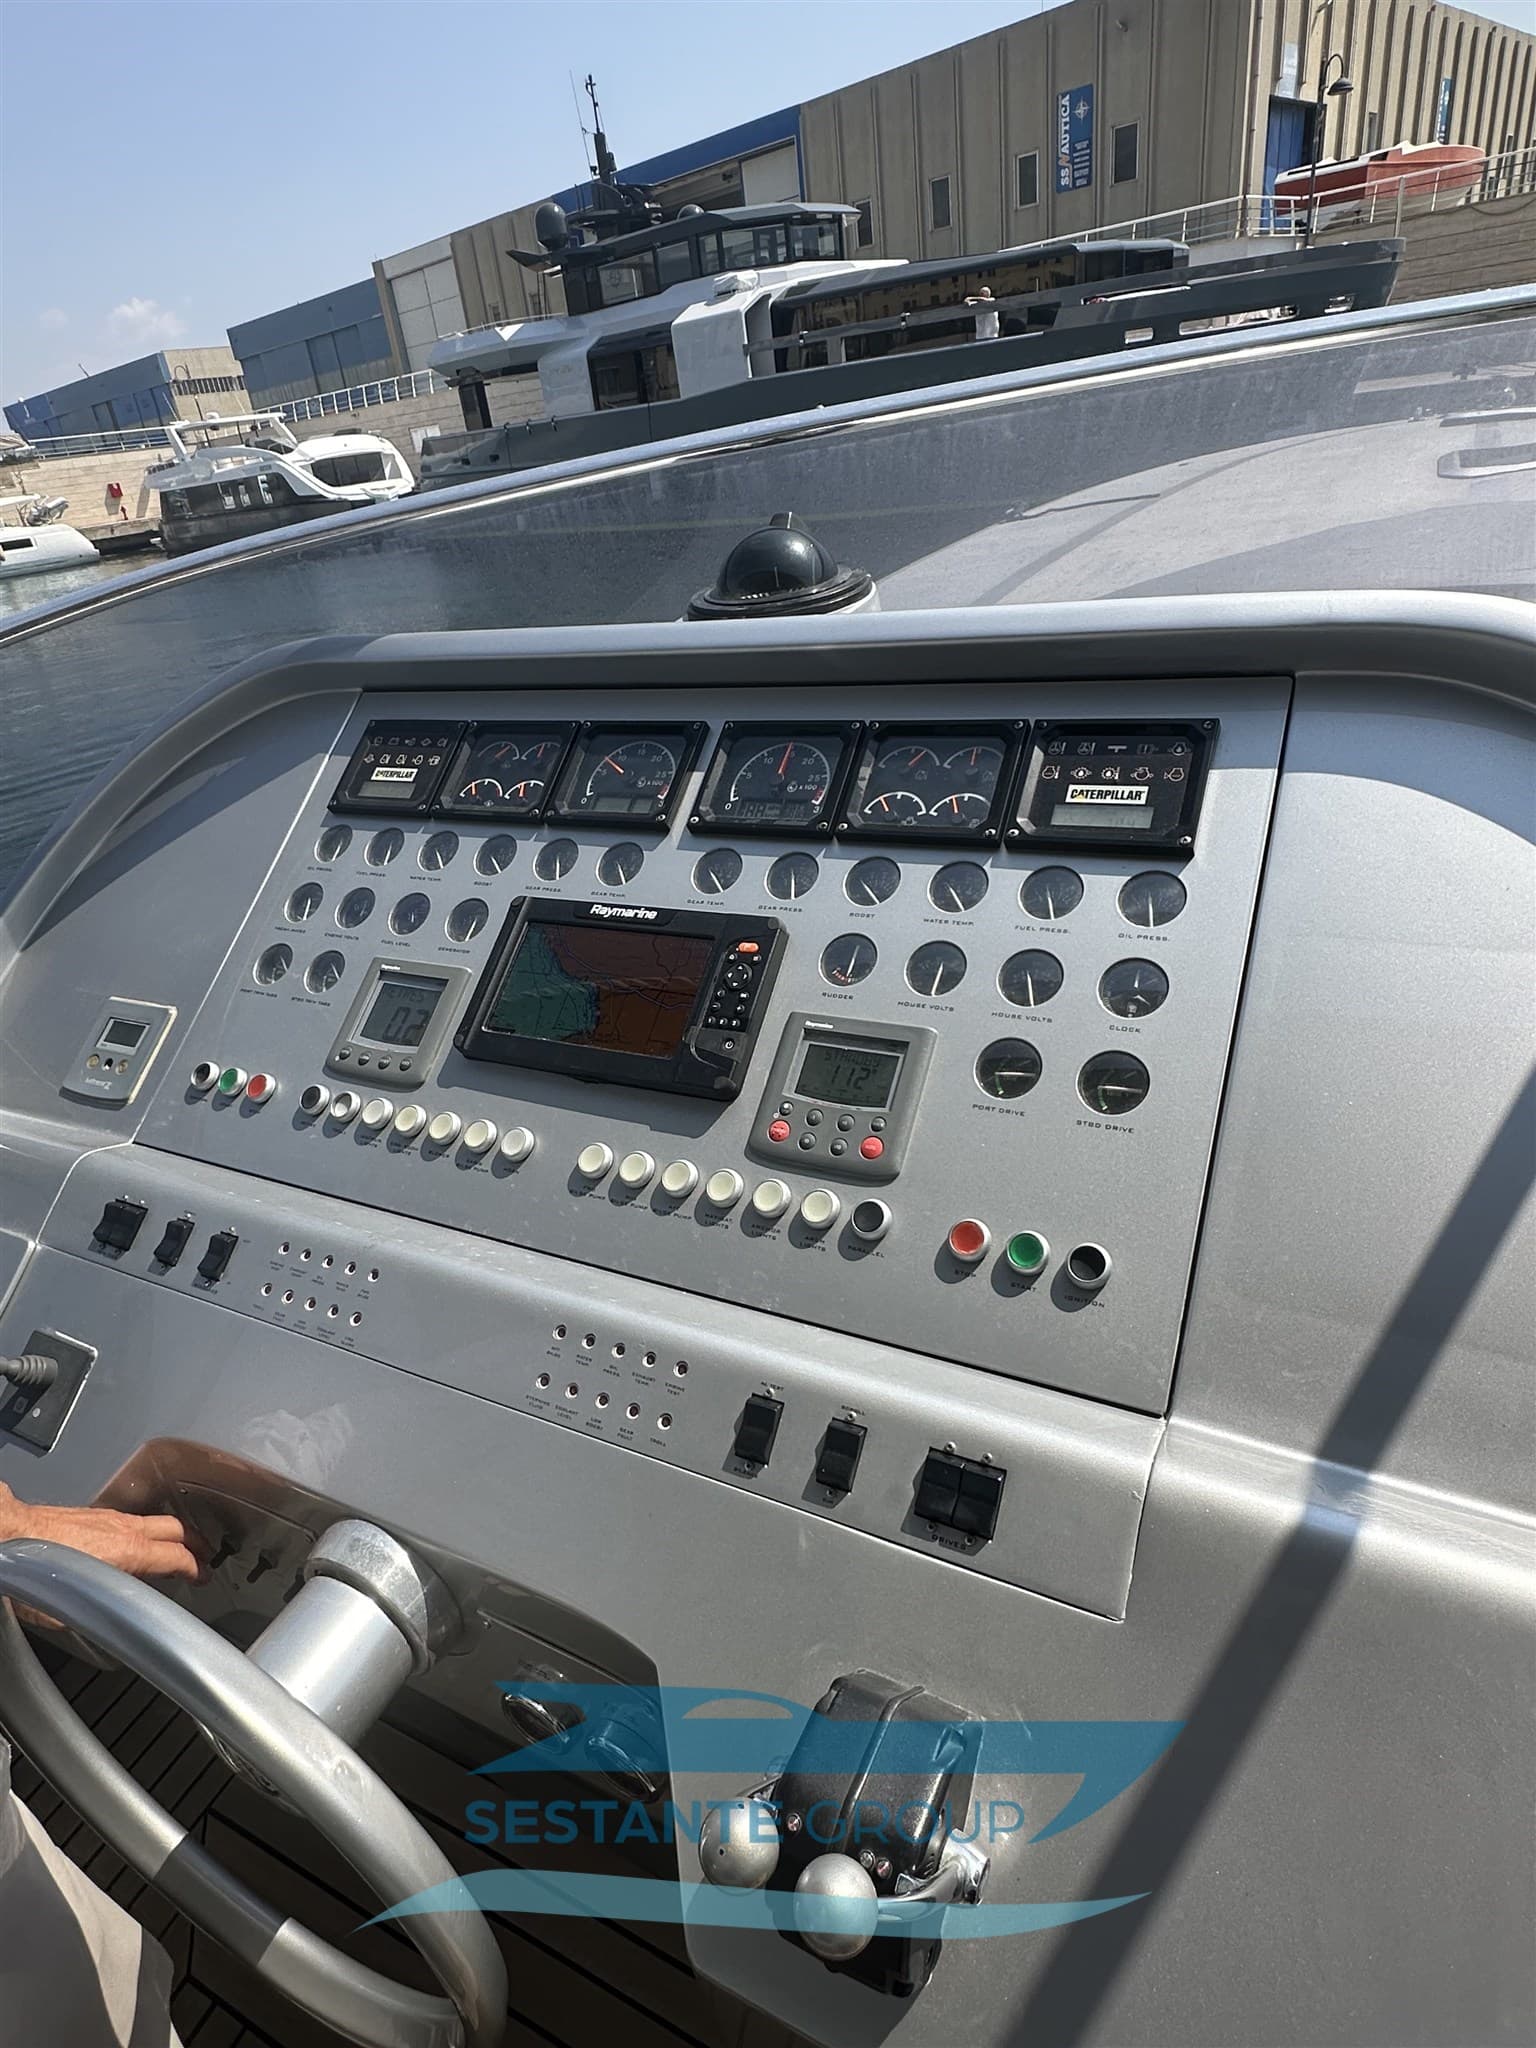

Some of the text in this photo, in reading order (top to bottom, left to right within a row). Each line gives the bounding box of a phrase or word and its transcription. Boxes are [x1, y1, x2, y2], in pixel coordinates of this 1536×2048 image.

[802, 757, 815, 765] 20
[1070, 789, 1142, 801] CATERPILLAR
[590, 903, 658, 920] Raymarine
[849, 911, 876, 919] BOOST
[923, 918, 949, 926] WATER
[1117, 932, 1134, 941] OIL
[821, 991, 854, 1000] RUDDER
[897, 1000, 955, 1013] HOUSE VOLTS
[991, 1011, 1054, 1024] HOUSE VOLTS
[1108, 1024, 1142, 1034] CLOCK
[972, 1103, 1027, 1118] PORT DRIVE
[1076, 1119, 1136, 1135] STBD DRIVE
[847, 1245, 885, 1259] PARALLEL
[954, 1269, 977, 1278] STOP
[1010, 1282, 1037, 1293] START
[1064, 1295, 1105, 1309] IGNITION
